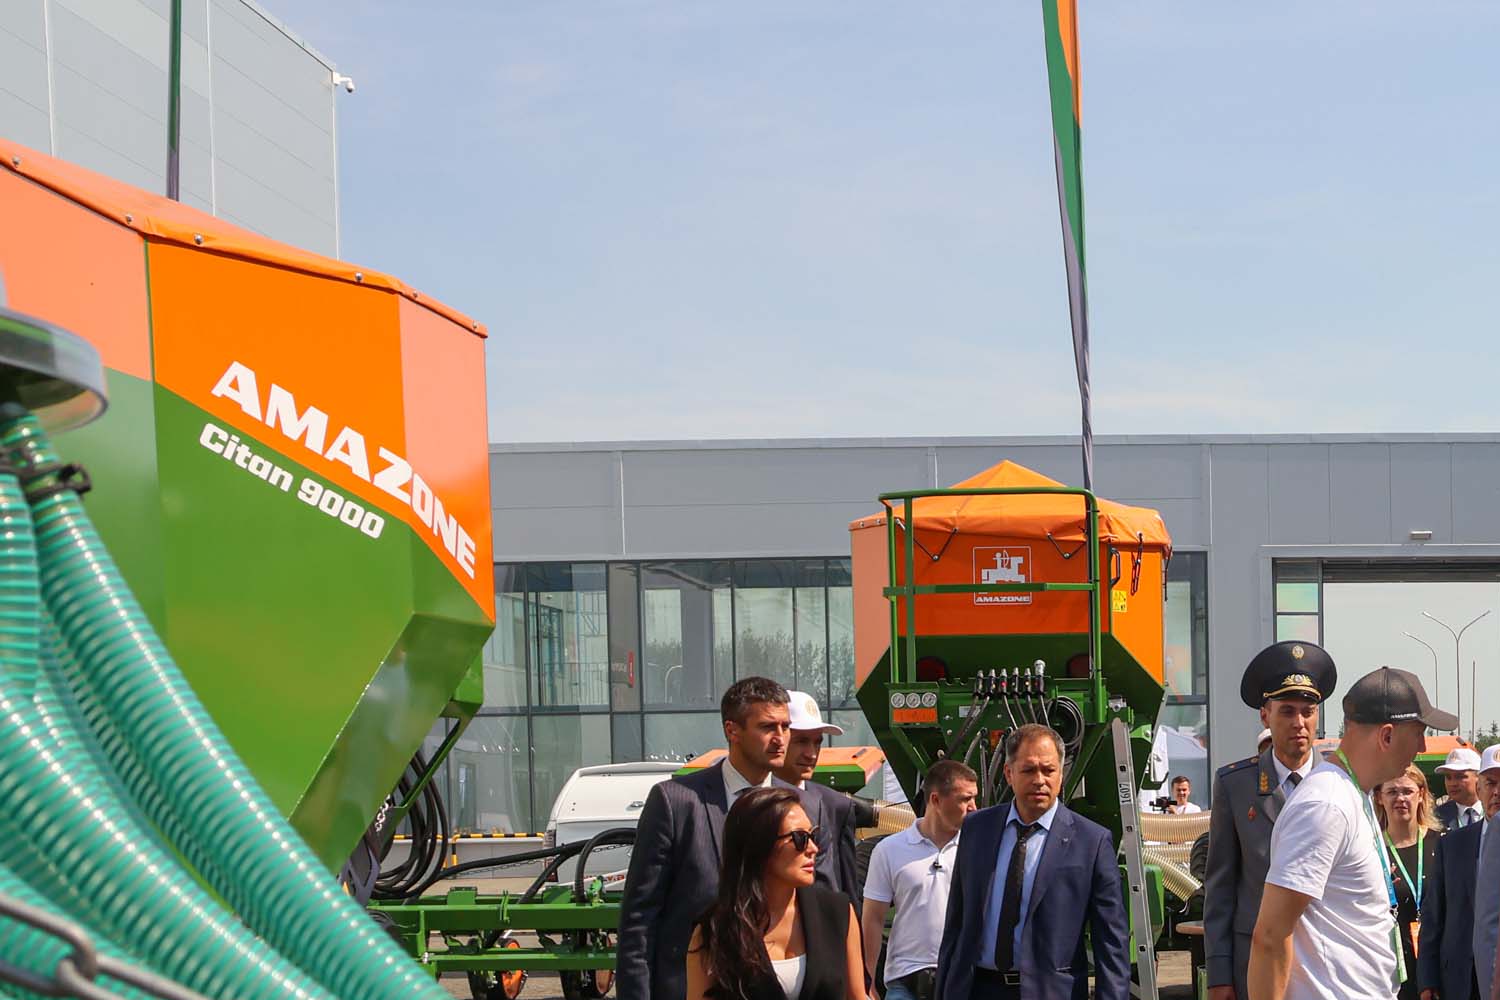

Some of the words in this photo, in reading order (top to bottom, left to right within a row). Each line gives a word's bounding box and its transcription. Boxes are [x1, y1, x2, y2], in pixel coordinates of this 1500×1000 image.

[199, 422, 294, 492] Citan
[297, 477, 385, 539] 9000
[210, 360, 476, 580] AMAZONE
